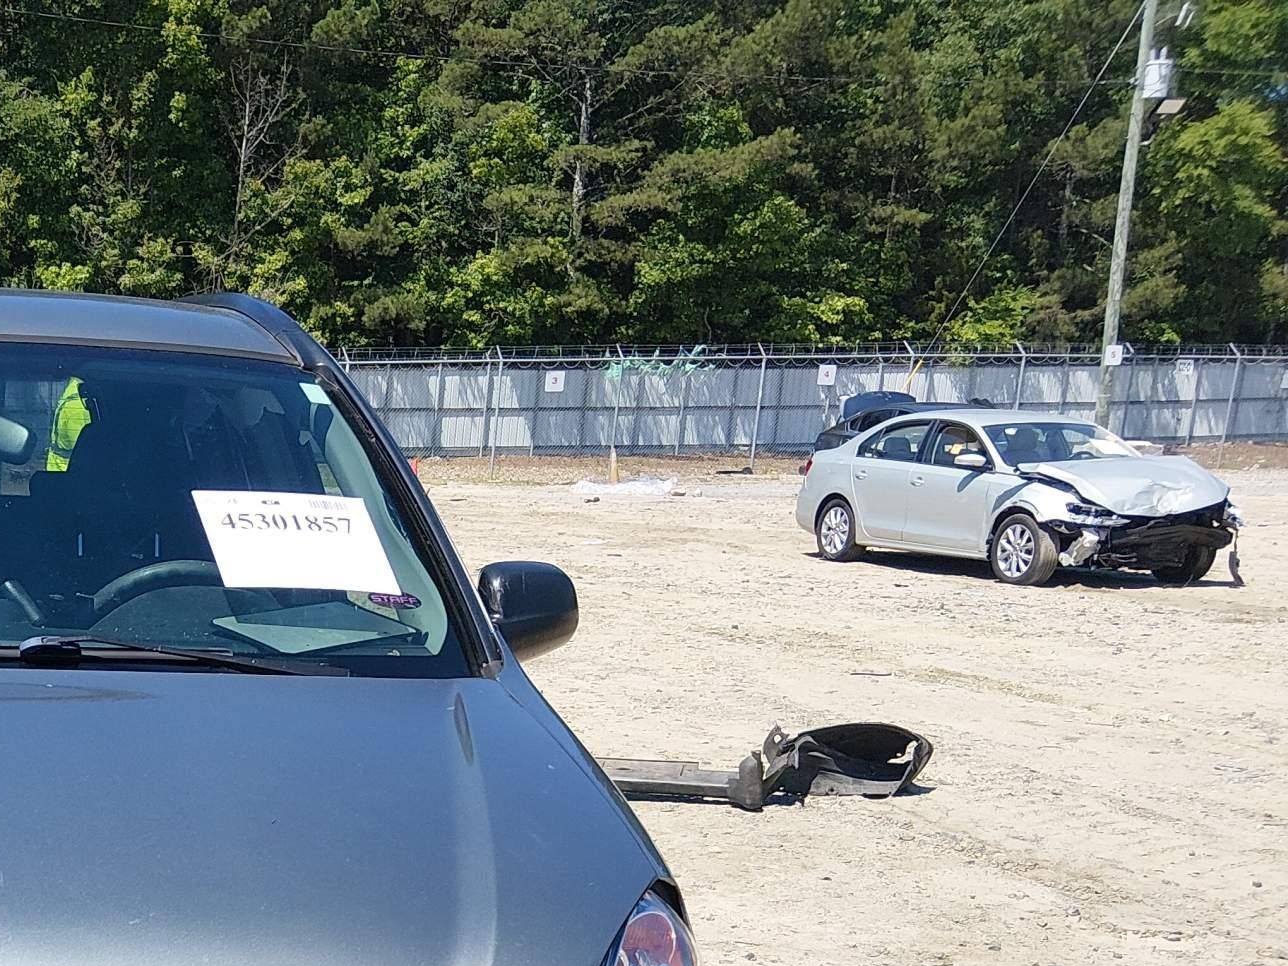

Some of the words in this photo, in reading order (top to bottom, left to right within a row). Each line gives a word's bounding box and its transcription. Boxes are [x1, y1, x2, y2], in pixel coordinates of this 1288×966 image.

[551, 376, 558, 385] 3
[220, 512, 352, 534] 45301857
[370, 594, 418, 604] STAFF
